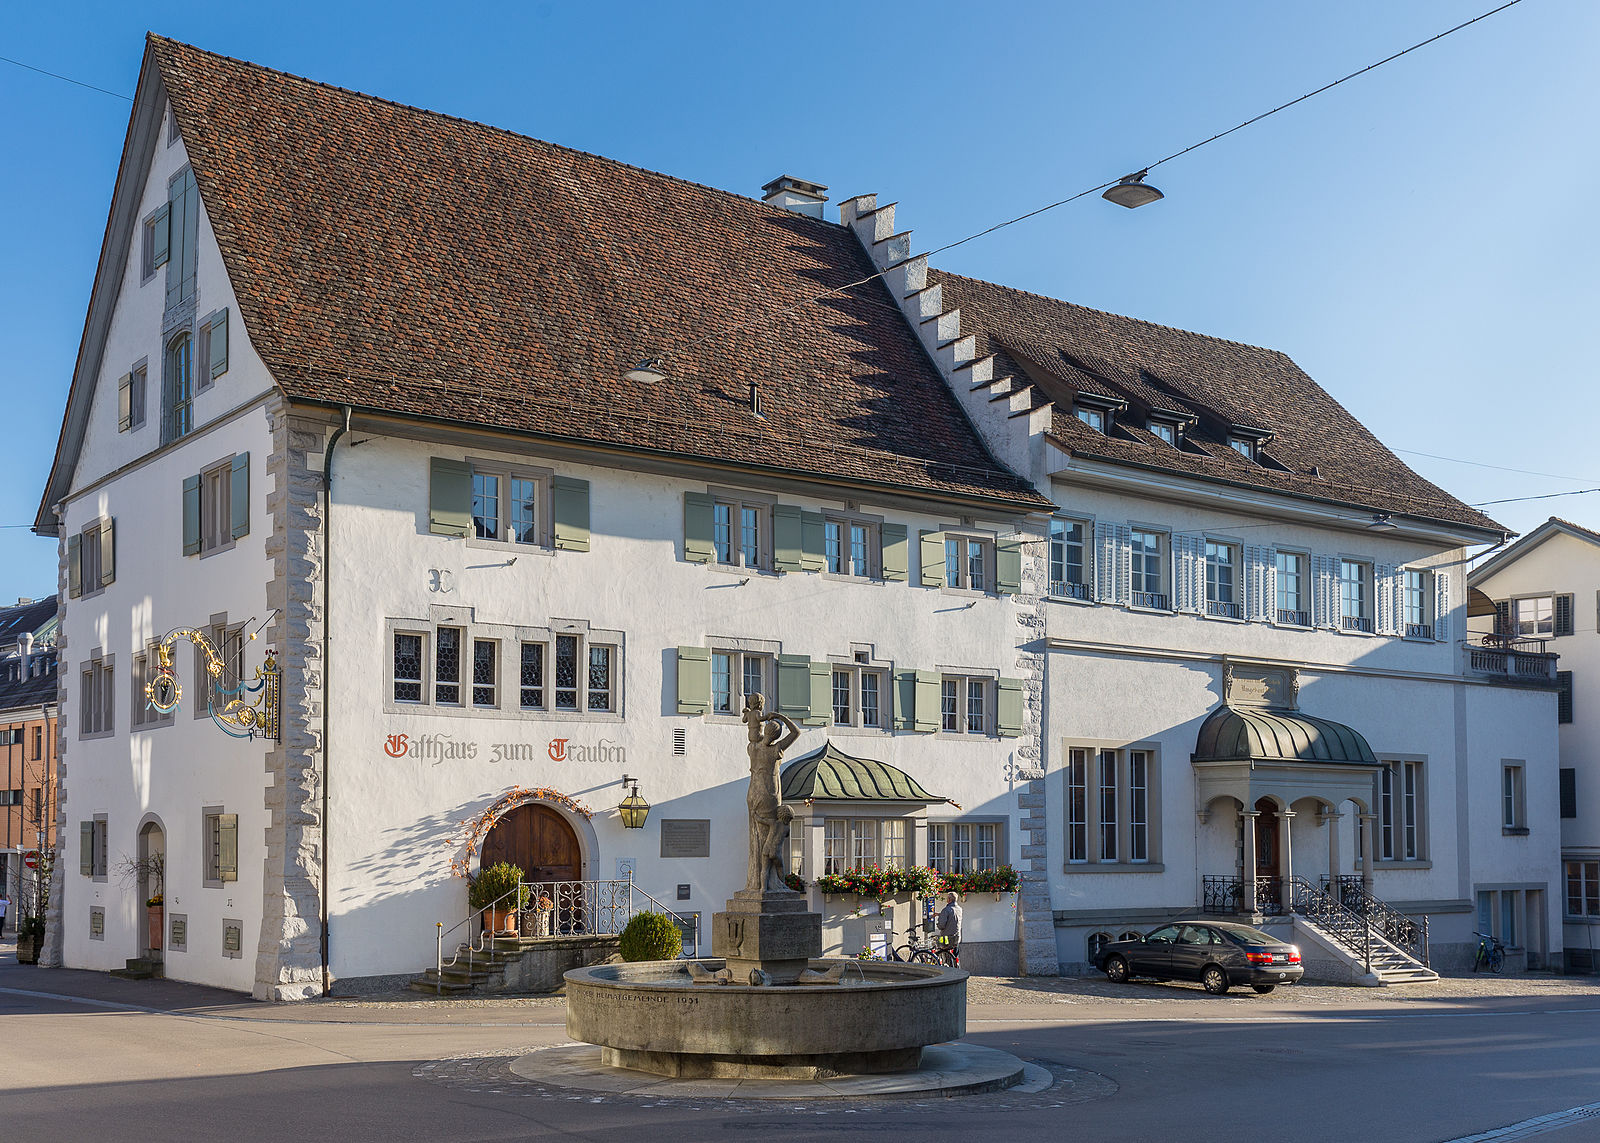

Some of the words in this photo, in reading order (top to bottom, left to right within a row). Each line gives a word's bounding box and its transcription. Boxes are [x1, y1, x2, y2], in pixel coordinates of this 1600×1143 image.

[384, 733, 478, 767] Gasthaus
[489, 742, 534, 763] zum
[548, 738, 627, 763] Trauben
